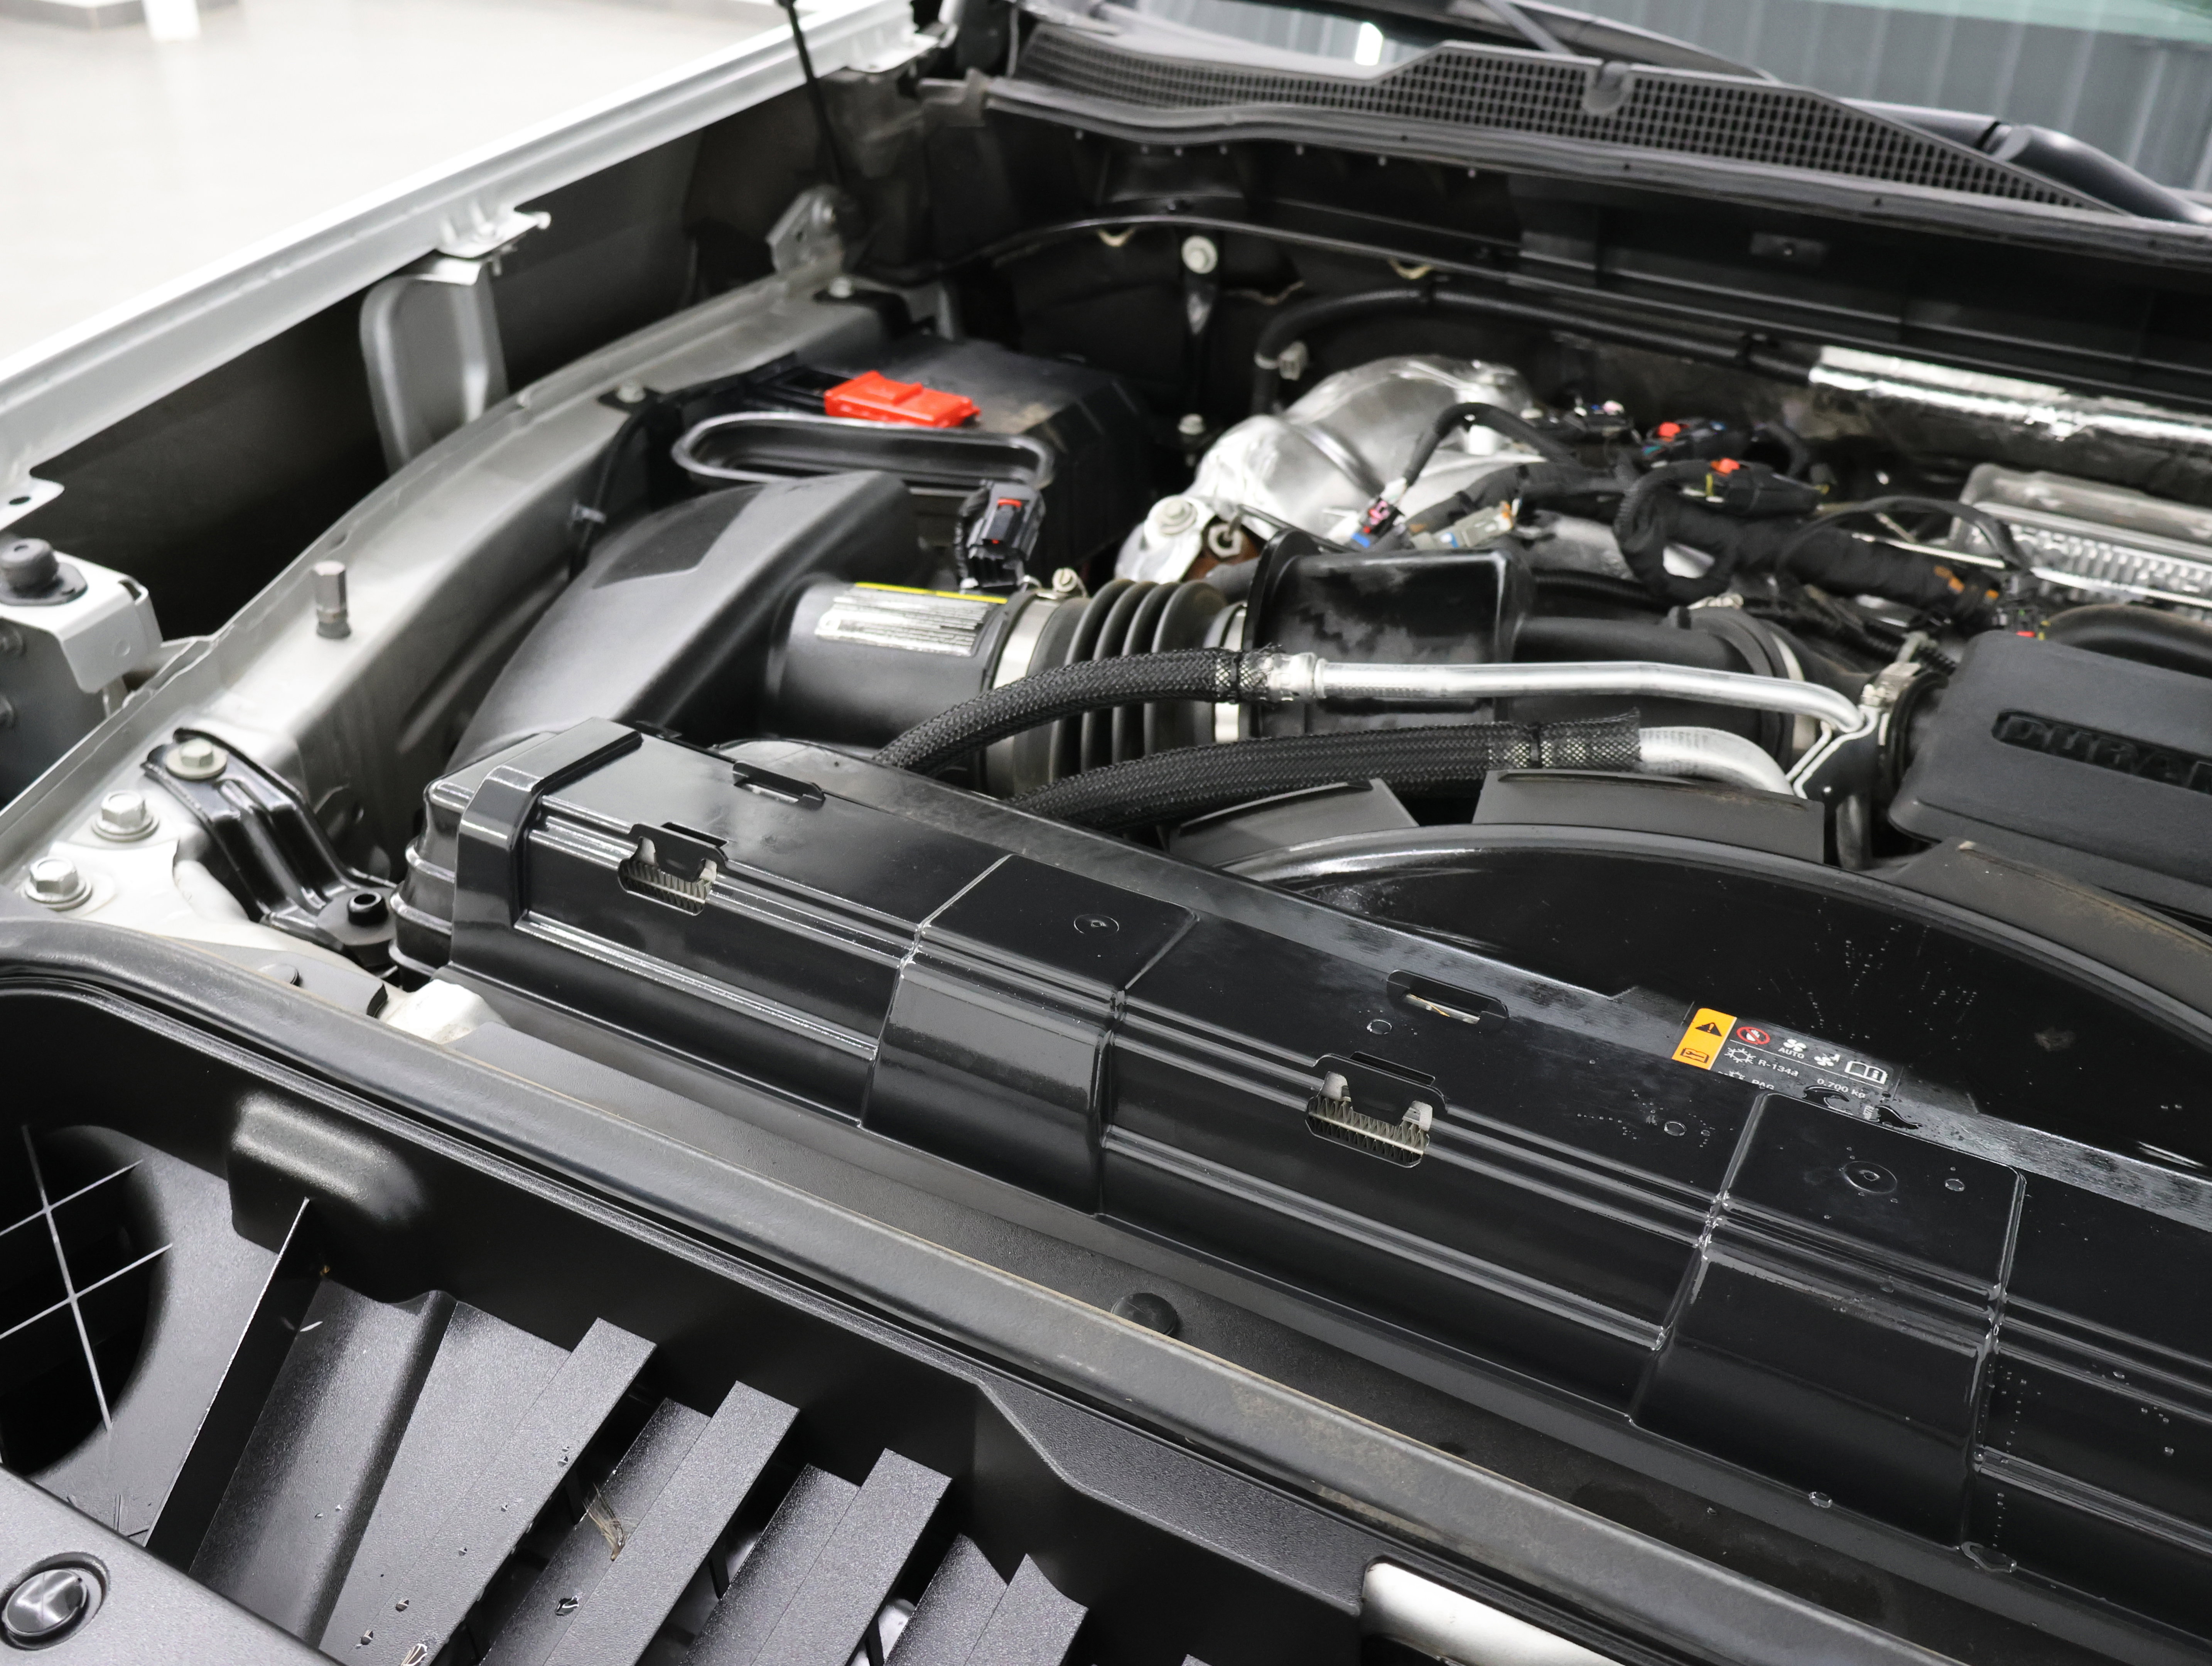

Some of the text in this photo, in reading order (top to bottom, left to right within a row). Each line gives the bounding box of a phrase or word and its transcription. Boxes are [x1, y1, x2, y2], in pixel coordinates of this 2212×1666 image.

[1778, 1047, 1805, 1059] AUTO
[1758, 1059, 1799, 1077] R-134a
[1817, 1078, 1866, 1099] 0.700 kg
